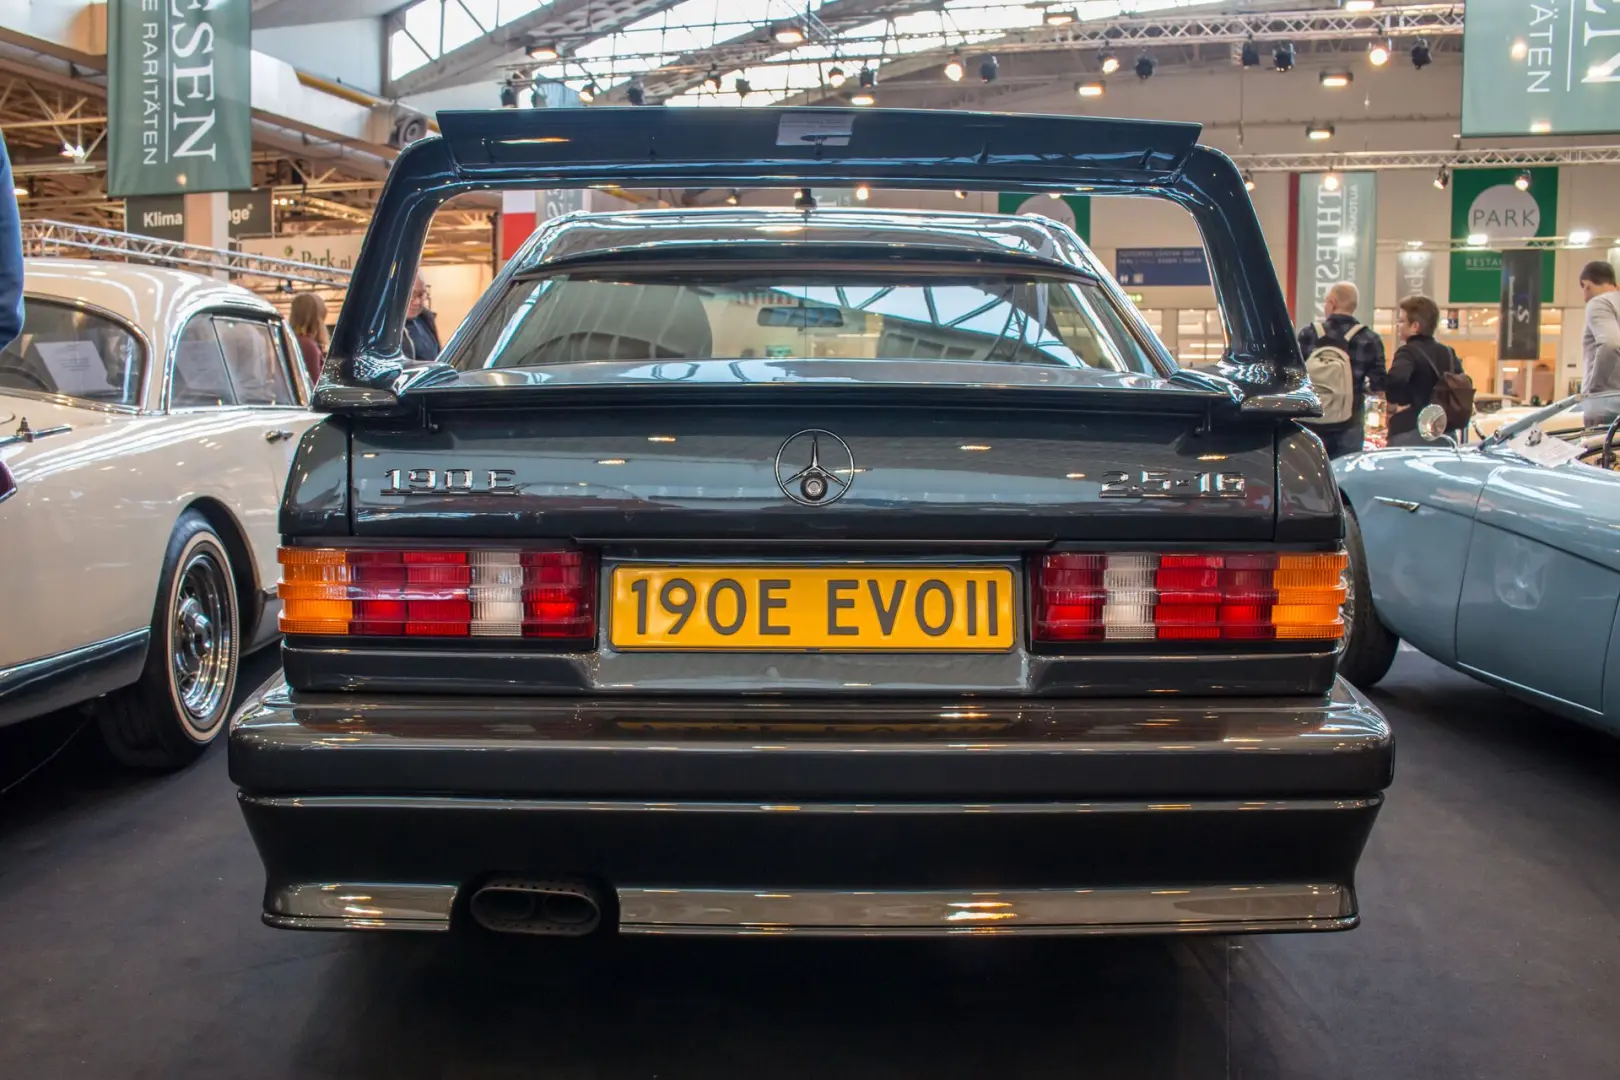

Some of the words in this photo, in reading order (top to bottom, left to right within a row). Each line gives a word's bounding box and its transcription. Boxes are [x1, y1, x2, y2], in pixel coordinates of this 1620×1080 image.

[1526, 0, 1559, 93] ÄTEN
[142, 22, 161, 165] RARITÄTEN
[143, 211, 183, 228] Klima
[1473, 209, 1536, 228] PARK
[1466, 257, 1502, 268] RESTA
[384, 468, 473, 492] 190
[487, 468, 517, 492] E
[630, 577, 791, 636] 190E
[827, 578, 999, 637] EVOII
